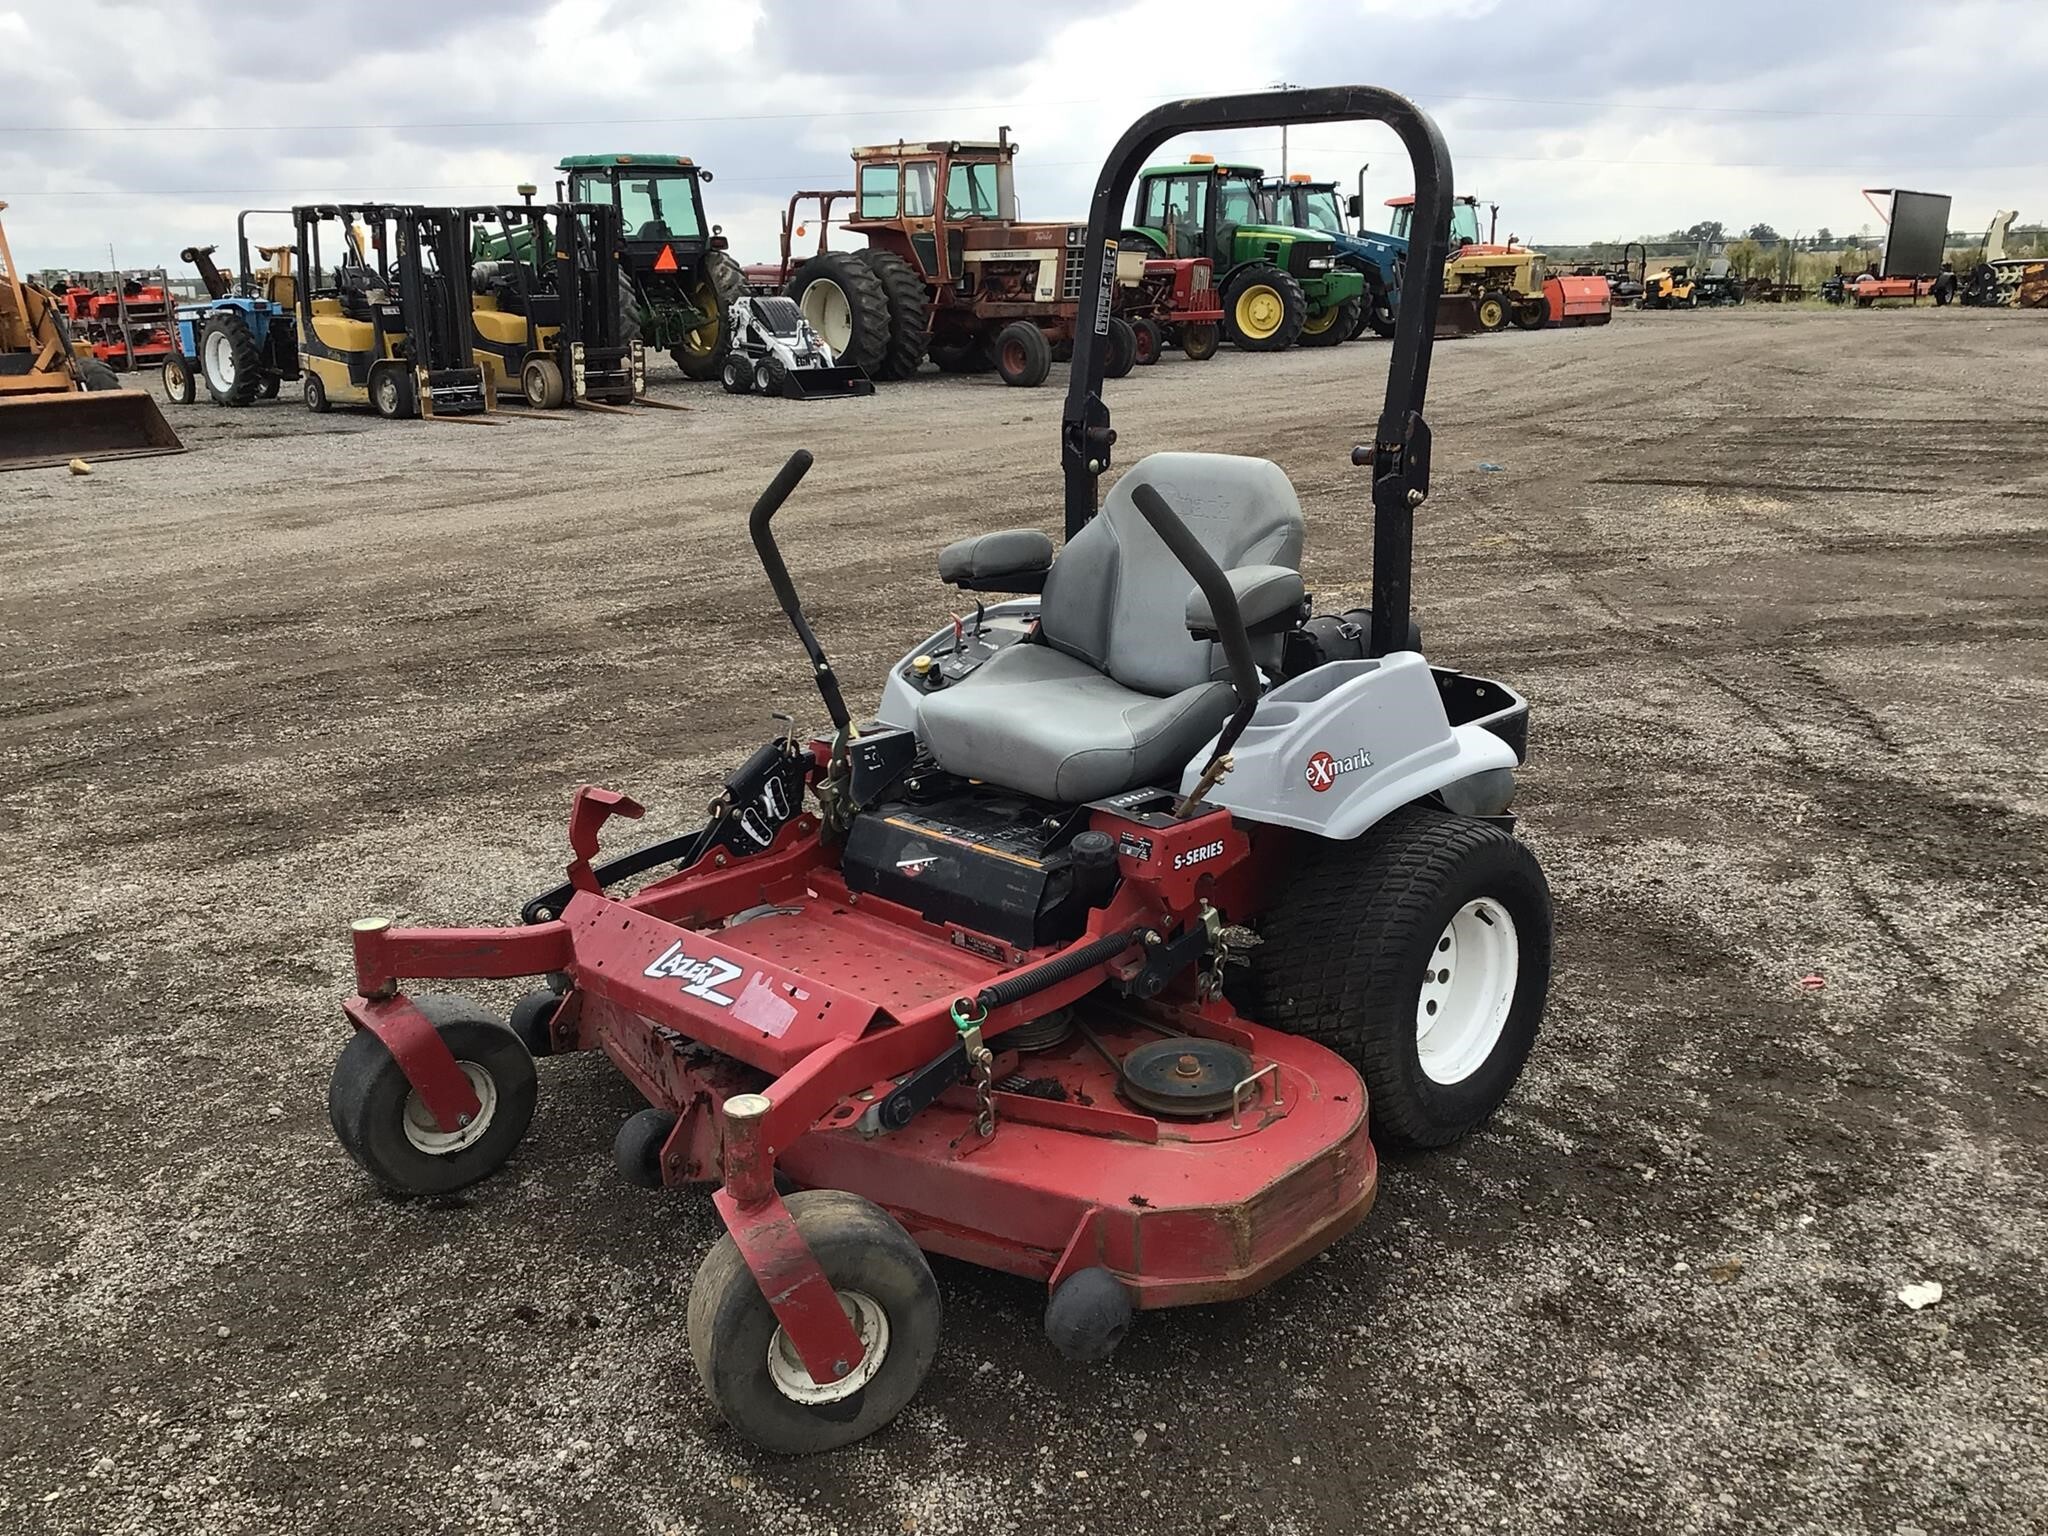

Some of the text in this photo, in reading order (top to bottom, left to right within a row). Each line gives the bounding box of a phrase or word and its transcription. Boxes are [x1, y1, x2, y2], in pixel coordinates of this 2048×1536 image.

[1305, 749, 1372, 787] eXmark
[1173, 840, 1225, 871] S-SERIES
[643, 938, 715, 986] LAZER
